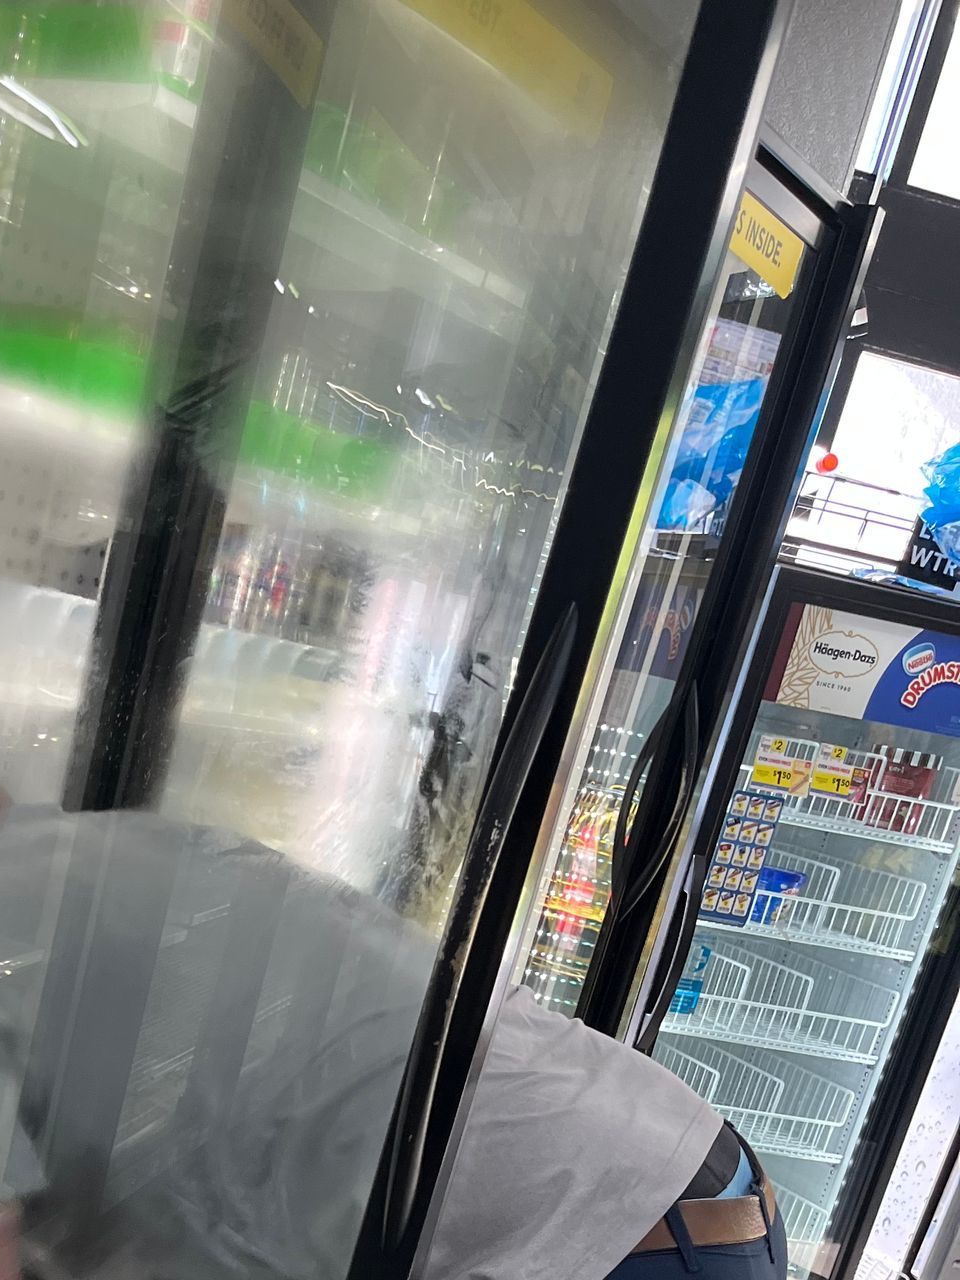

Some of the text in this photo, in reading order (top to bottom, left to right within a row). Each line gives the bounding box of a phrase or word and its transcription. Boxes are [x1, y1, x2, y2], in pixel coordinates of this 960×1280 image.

[745, 217, 783, 267] INSIDE.
[814, 642, 876, 665] Häagen-Dazs
[816, 681, 835, 690] SINCE
